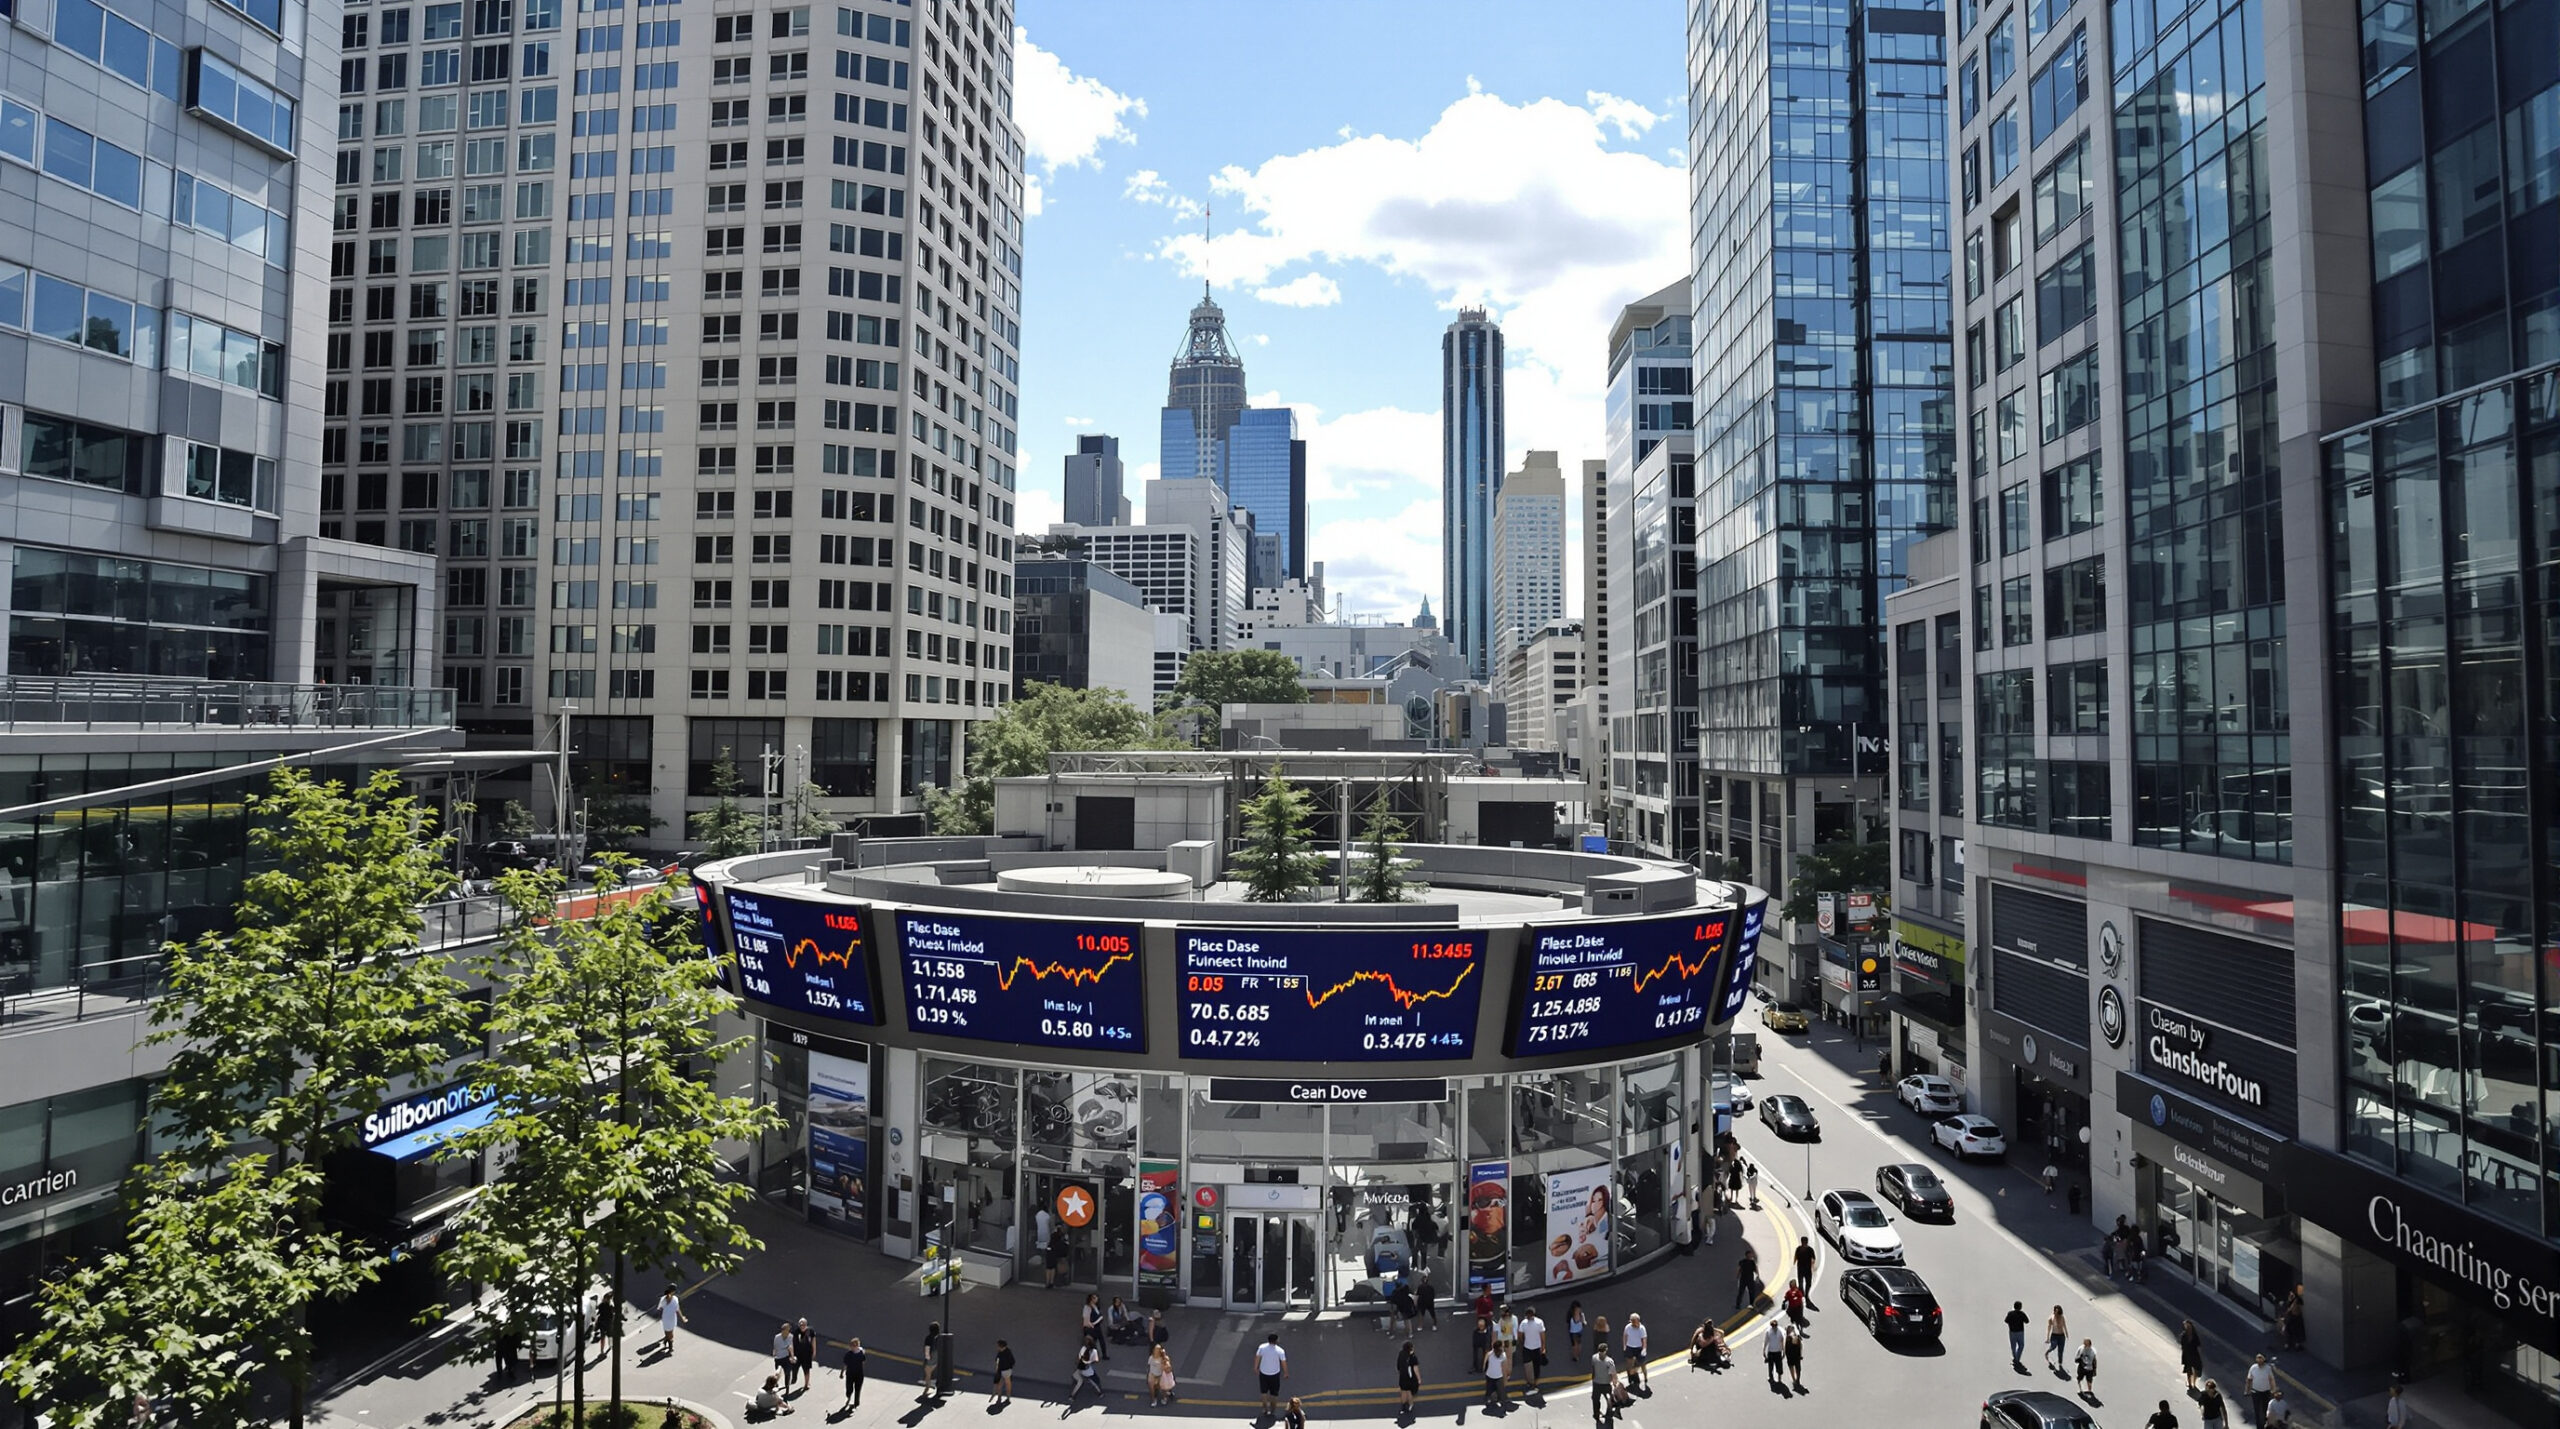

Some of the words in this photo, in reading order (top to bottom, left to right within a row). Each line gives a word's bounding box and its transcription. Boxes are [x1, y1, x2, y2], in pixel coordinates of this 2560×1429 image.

[1076, 934, 1131, 953] 10.005
[1041, 1018, 1093, 1038] 0.5.80
[2190, 1021, 2206, 1050] by
[1330, 1085, 1368, 1099] Dove
[2368, 1195, 2513, 1309] Chaanting
